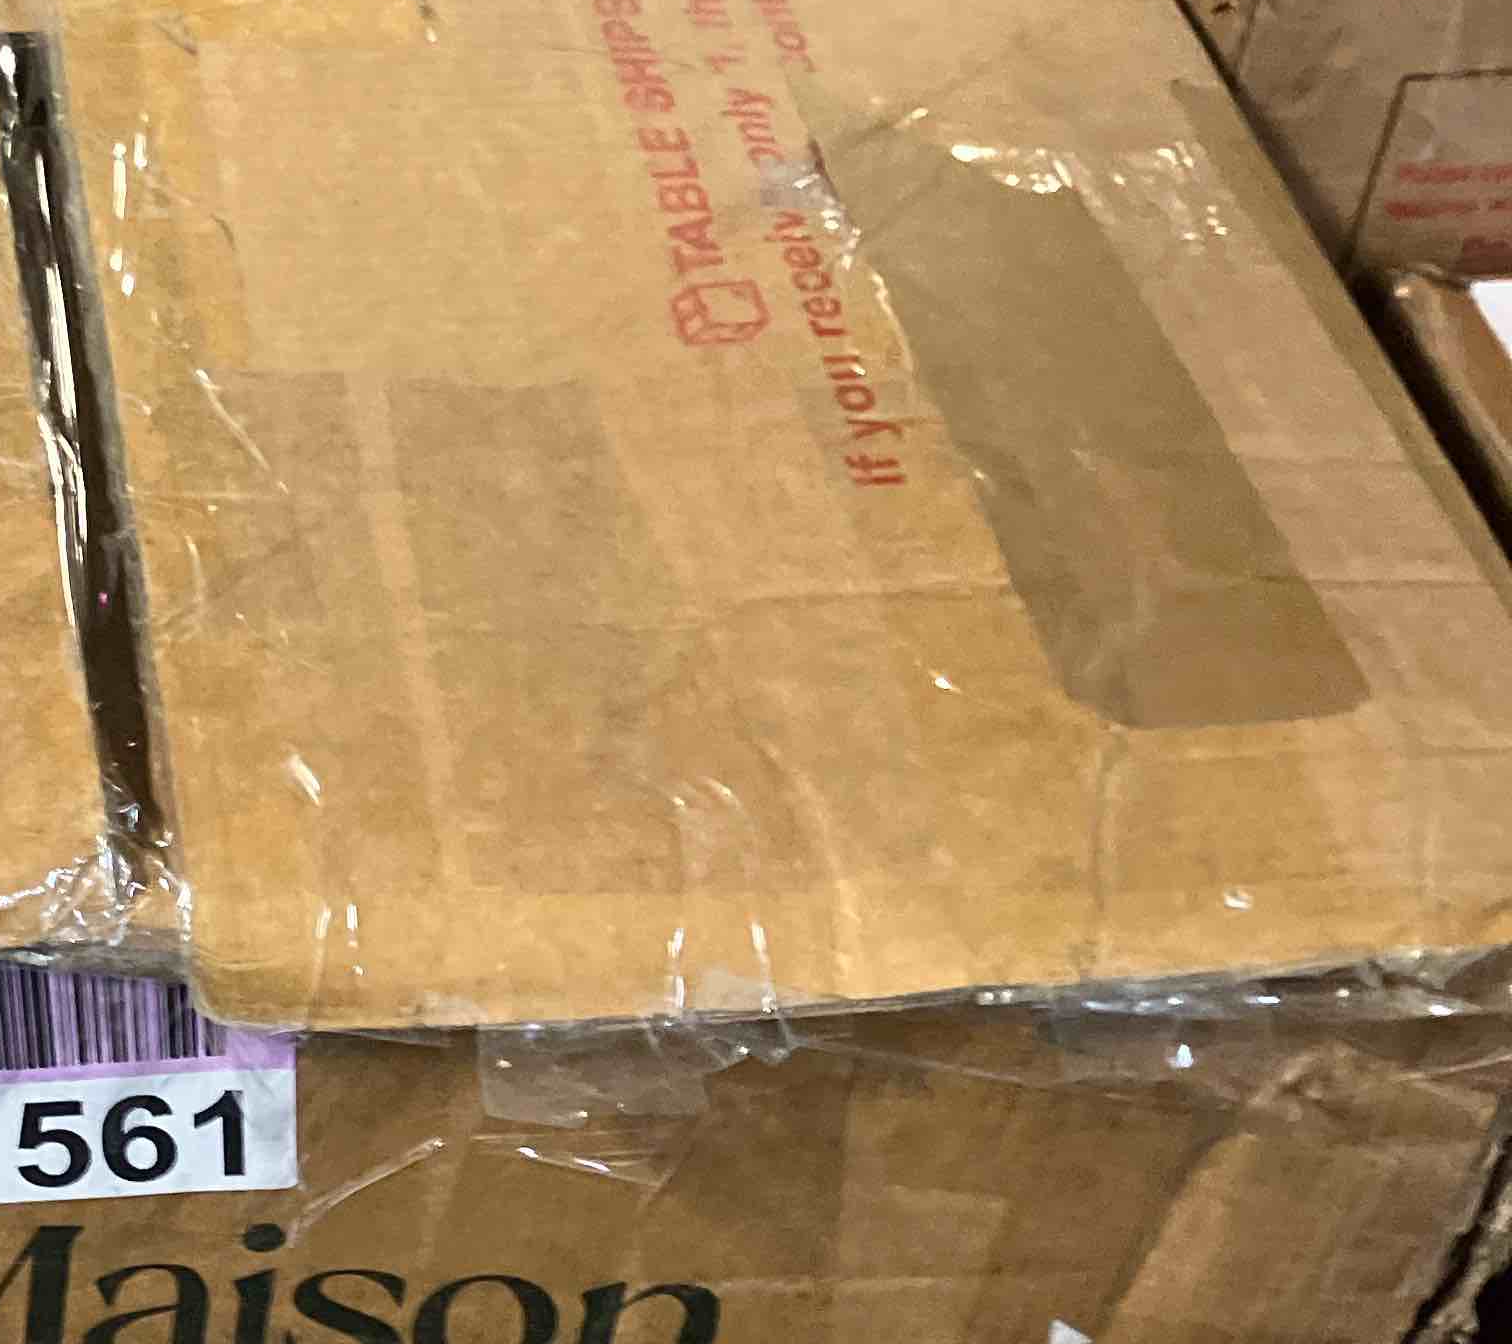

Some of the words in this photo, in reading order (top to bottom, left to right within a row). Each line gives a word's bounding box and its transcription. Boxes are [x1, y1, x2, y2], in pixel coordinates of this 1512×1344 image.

[641, 127, 723, 273] TABLE
[769, 211, 847, 338] receiv
[825, 354, 904, 442] you
[846, 456, 906, 487] If
[16, 1091, 251, 1190] 561
